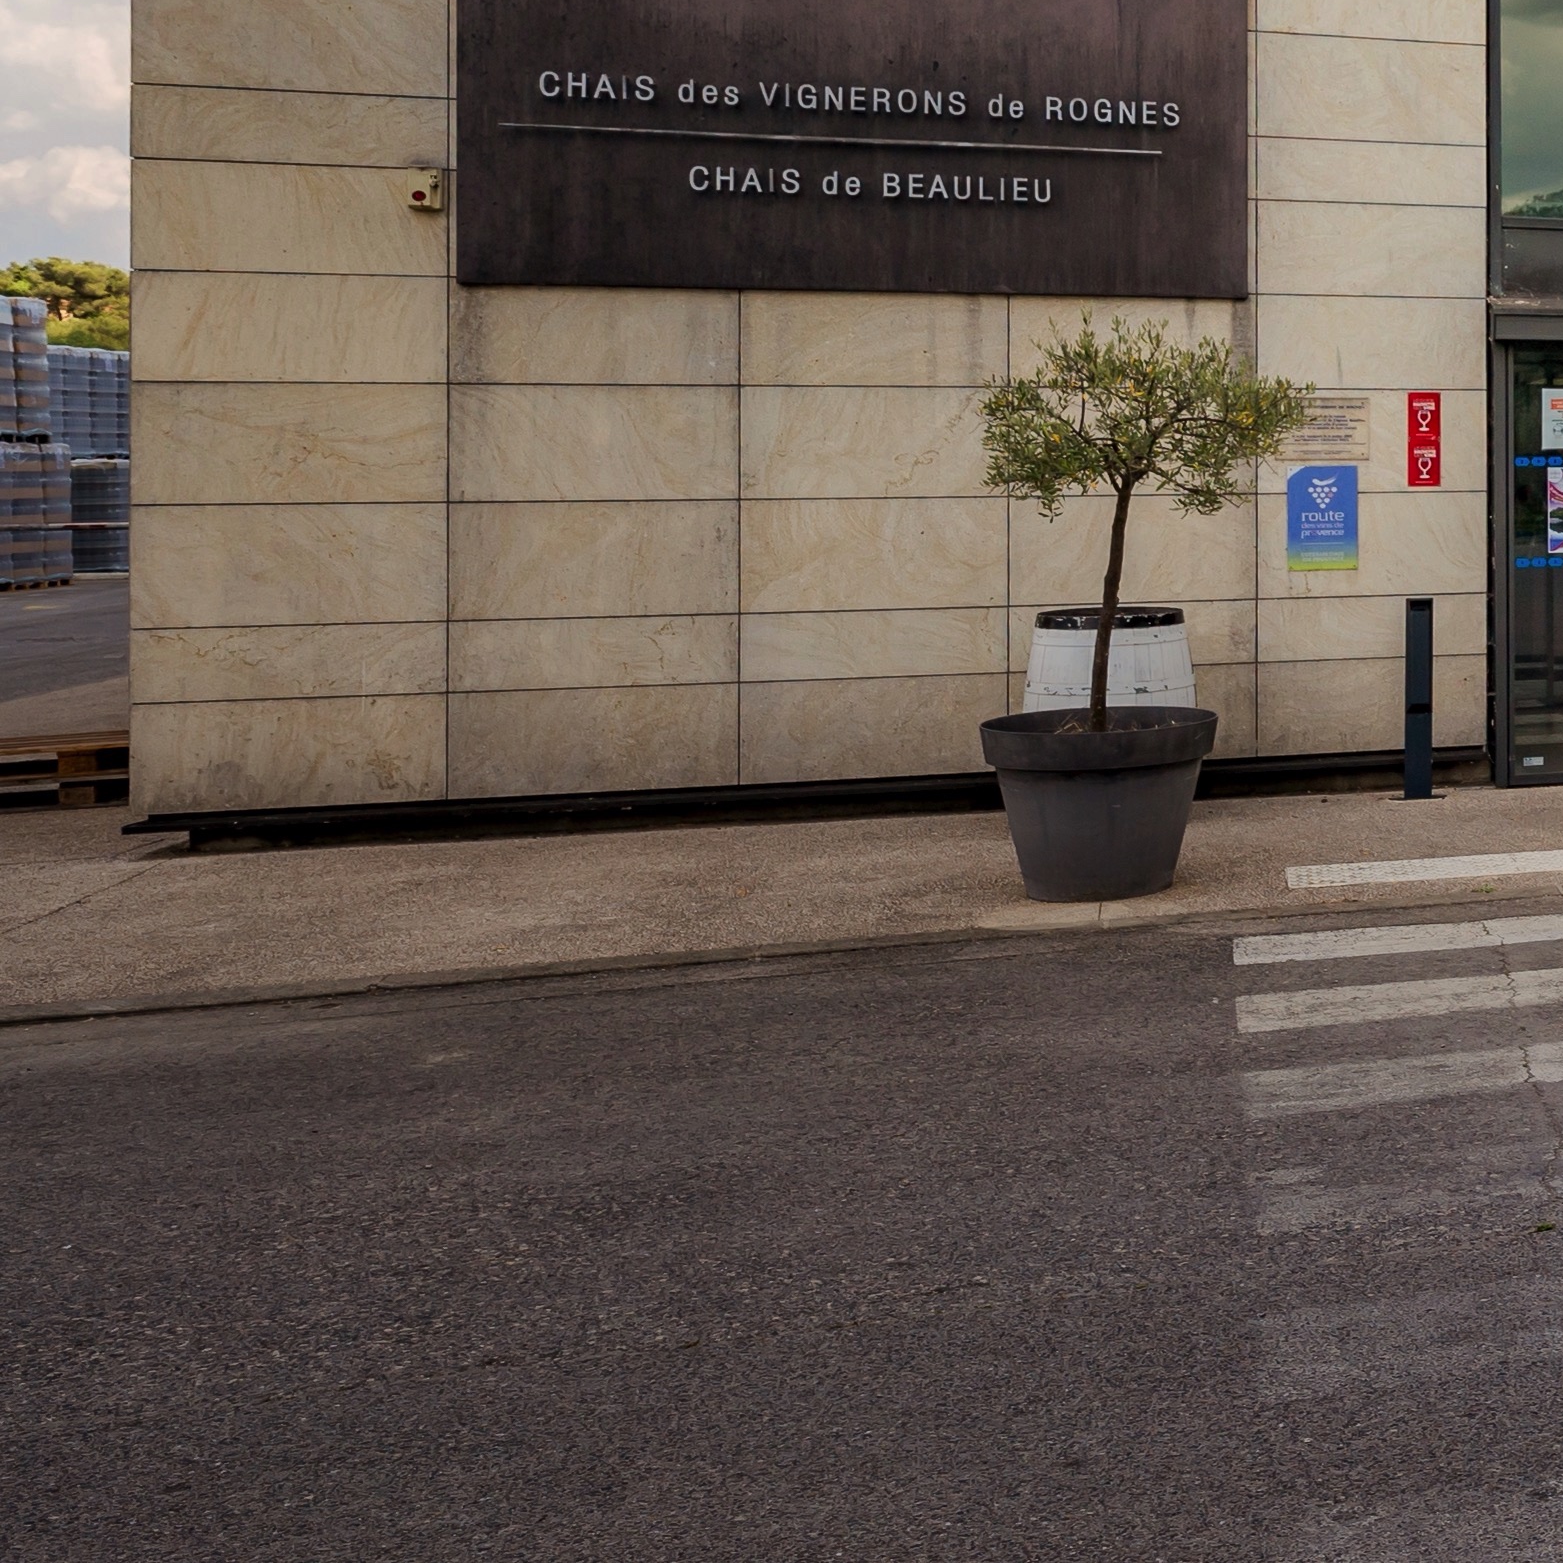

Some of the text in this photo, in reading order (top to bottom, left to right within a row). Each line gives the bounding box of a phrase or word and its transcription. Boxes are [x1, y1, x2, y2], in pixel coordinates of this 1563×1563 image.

[537, 69, 1183, 129] CHAIS des VIGNERONS de ROGNES
[687, 164, 1054, 205] CHAIS de BEAULIEU
[1301, 511, 1345, 522] route
